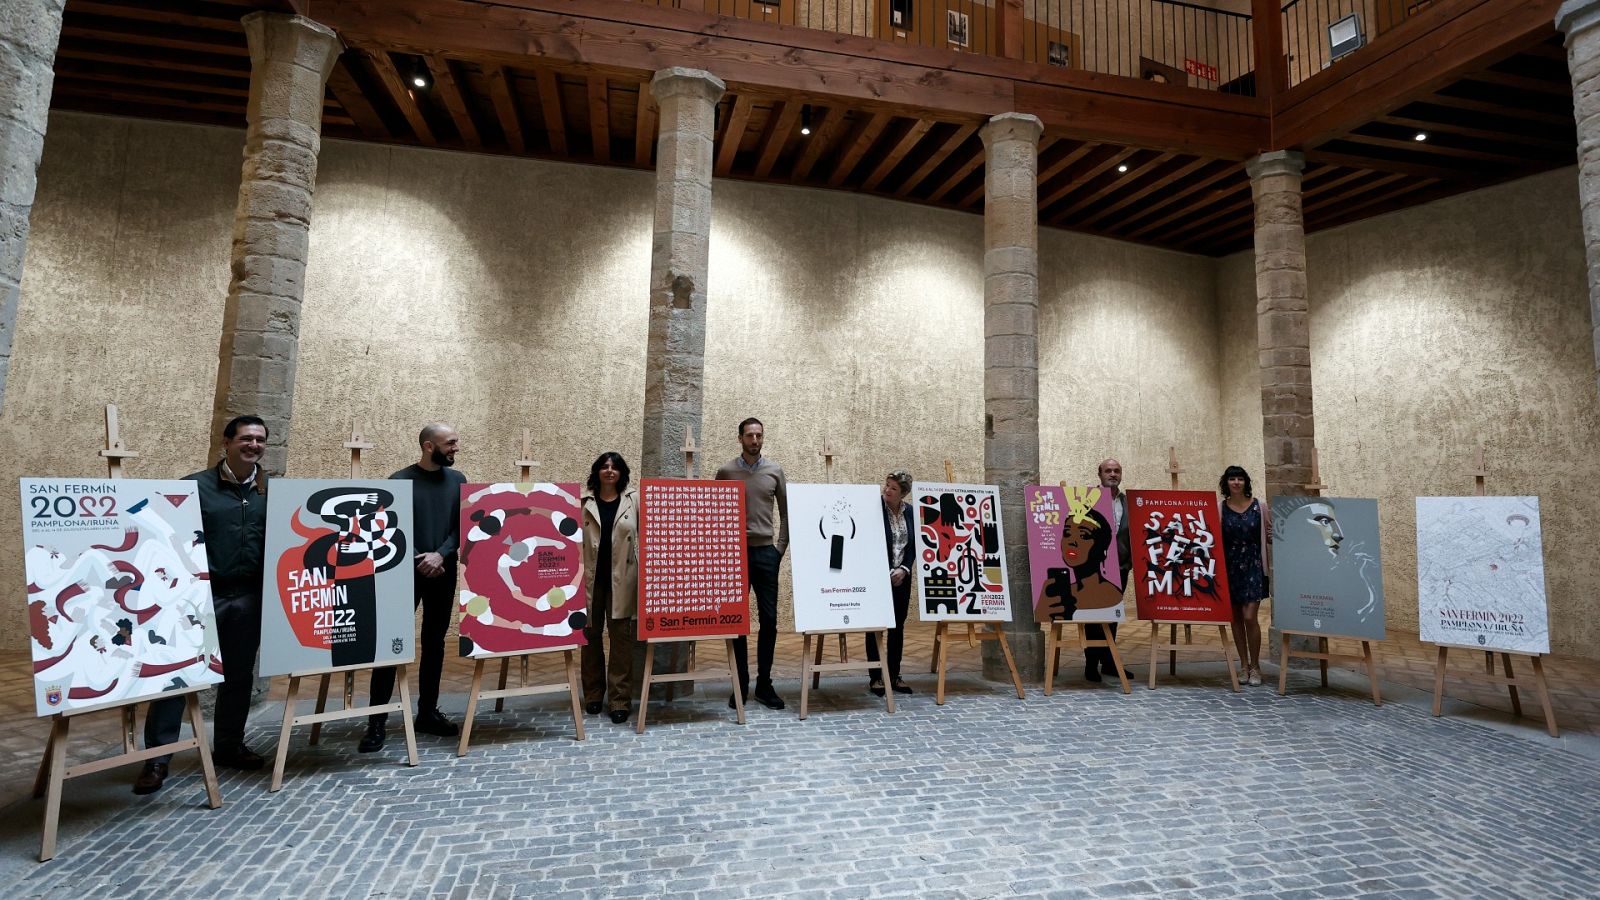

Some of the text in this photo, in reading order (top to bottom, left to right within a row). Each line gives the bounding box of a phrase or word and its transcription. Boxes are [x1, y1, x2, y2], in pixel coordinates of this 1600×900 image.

[29, 483, 117, 494] SAN FERMÍN
[31, 496, 118, 518] 2022
[1033, 511, 1060, 525] 2022
[1144, 510, 1207, 535] SAN
[287, 566, 327, 590] SAN
[313, 609, 355, 628] 2022
[660, 617, 680, 627] San
[719, 614, 743, 624] 2022
[1440, 608, 1457, 619] SAN
[1499, 613, 1524, 624] 2022
